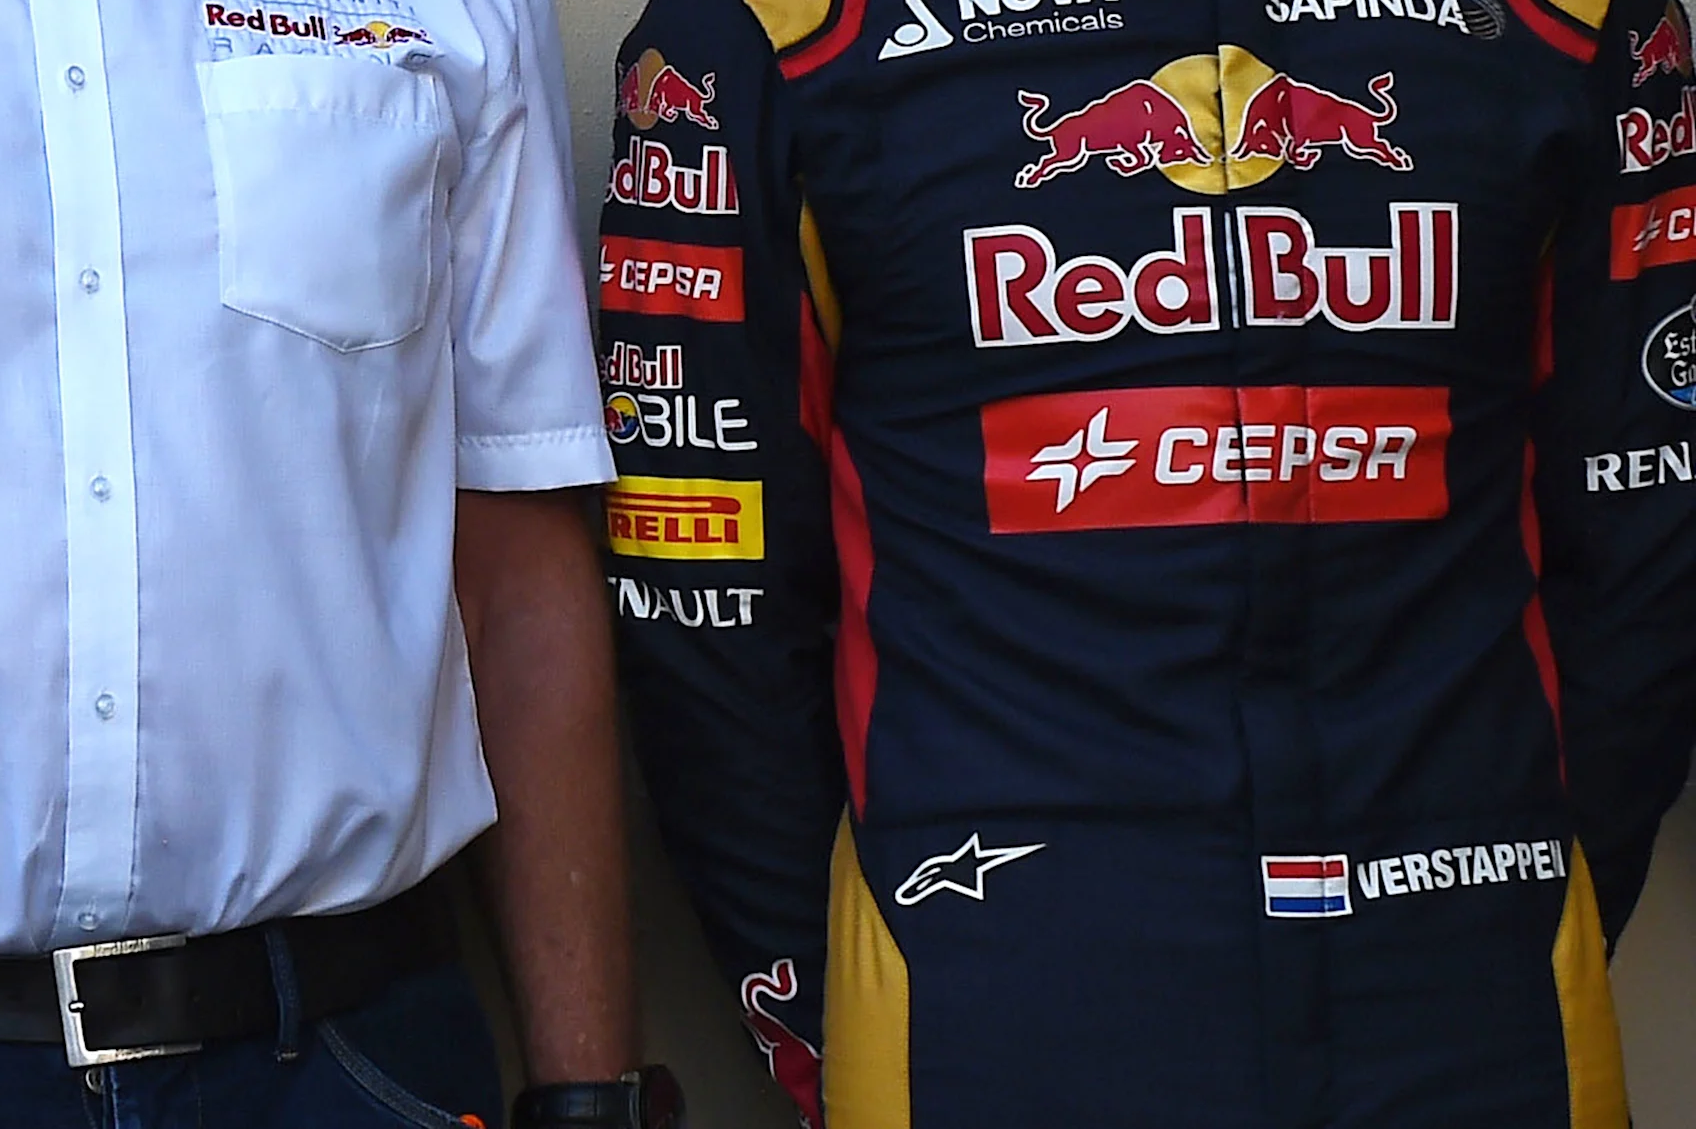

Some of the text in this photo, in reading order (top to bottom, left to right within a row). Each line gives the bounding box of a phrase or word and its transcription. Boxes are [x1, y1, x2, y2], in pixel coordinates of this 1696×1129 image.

[205, 3, 327, 41] Red Bull
[963, 8, 1124, 43] Chemicals
[639, 140, 740, 215] Bull
[620, 259, 722, 300] CEPSA
[964, 202, 1459, 348] Red Bull
[626, 344, 683, 389] Bull
[606, 392, 758, 450] OBILE
[1154, 424, 1417, 485] CEPSA
[607, 503, 741, 544] RELLI
[608, 576, 764, 627] NAULT
